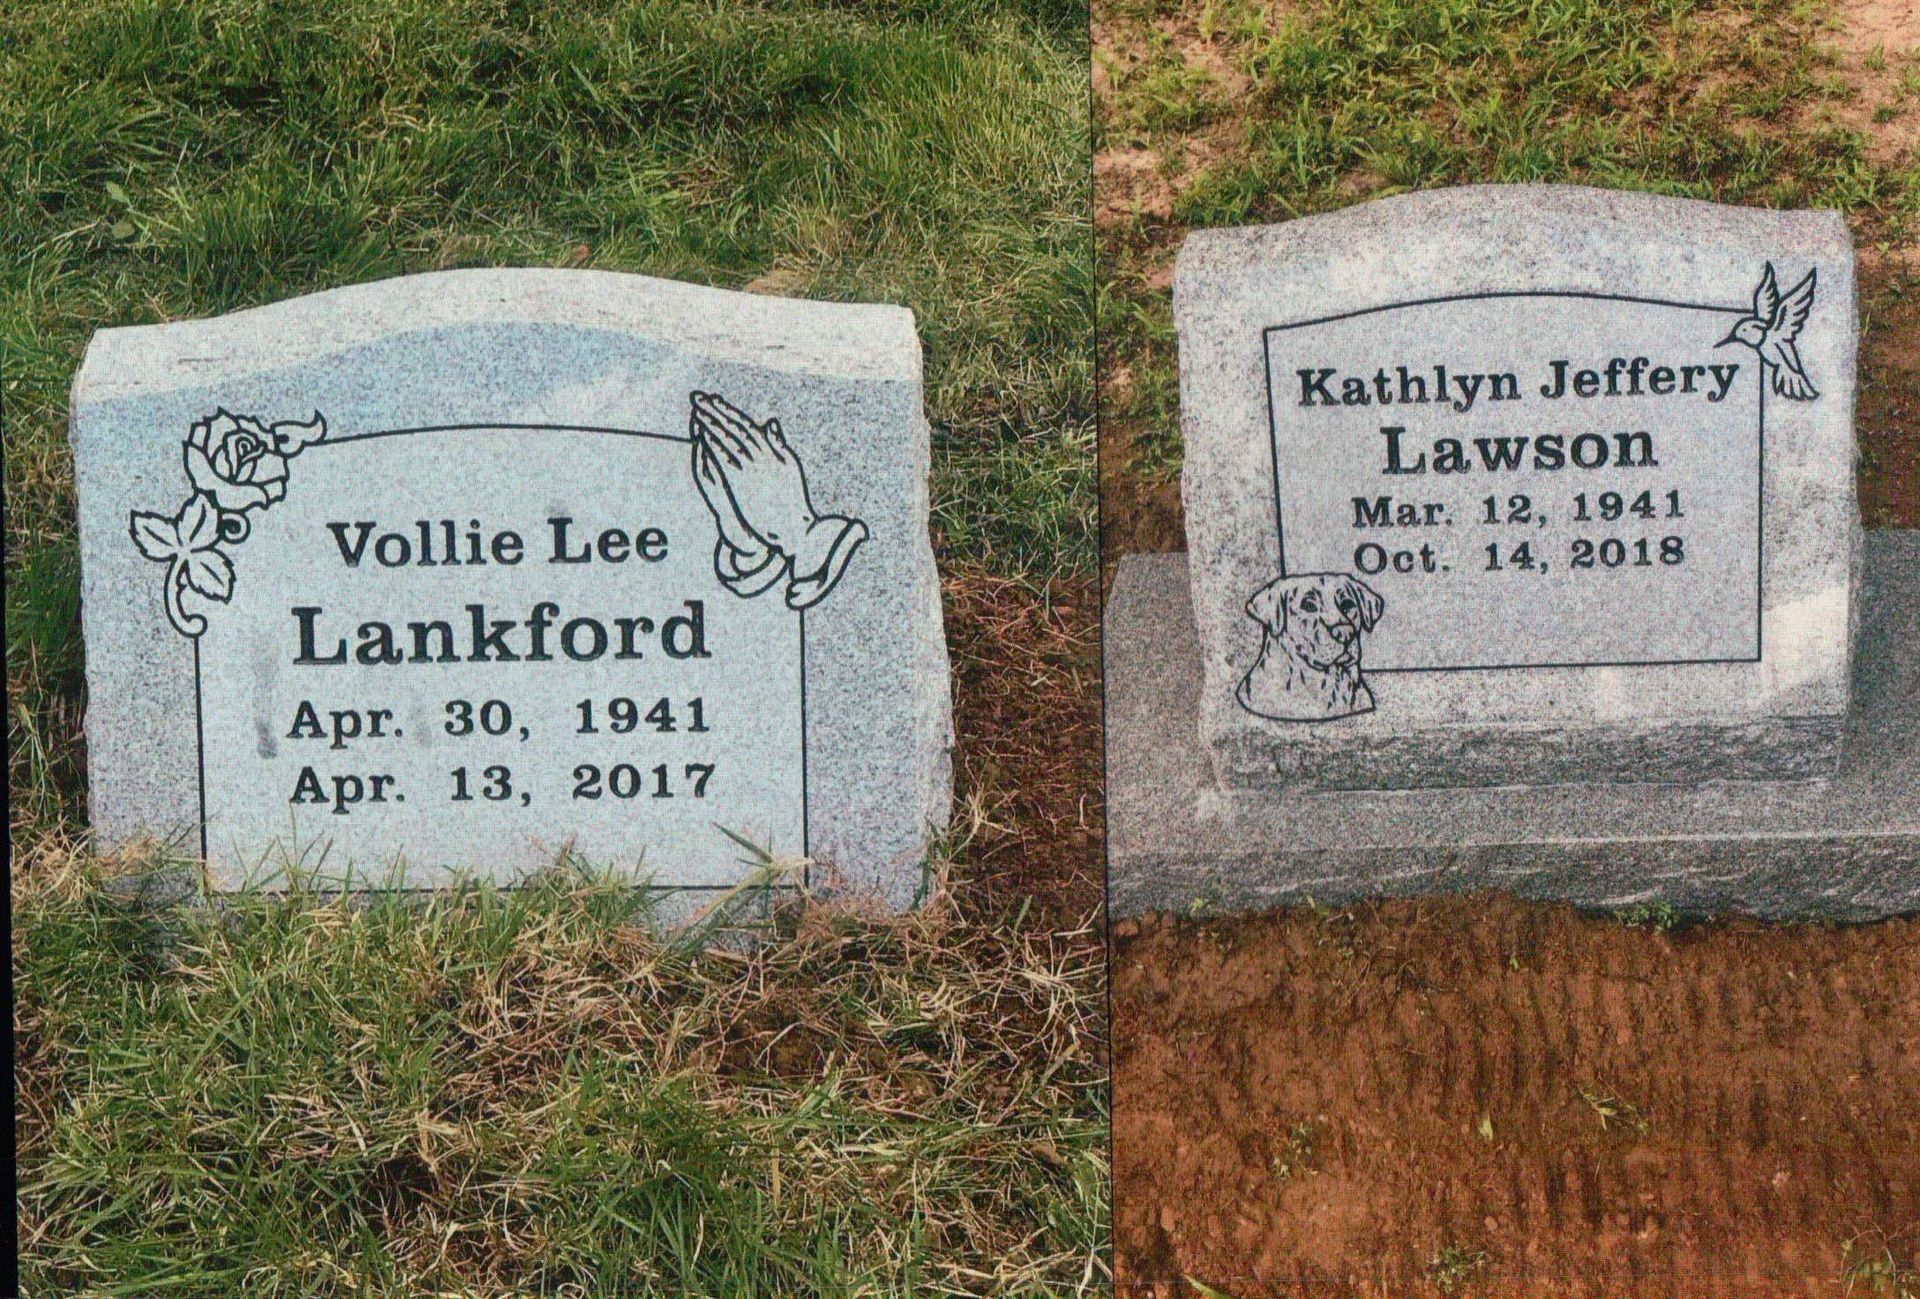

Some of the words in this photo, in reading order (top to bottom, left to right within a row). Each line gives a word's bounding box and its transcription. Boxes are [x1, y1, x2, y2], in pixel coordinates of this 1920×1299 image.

[1296, 364, 1522, 413] Kathlyn
[1540, 357, 1740, 402] Jeffery
[1380, 426, 1659, 475] Lawson
[1351, 495, 1452, 528] Mar.
[1482, 494, 1547, 528] 12,
[1572, 489, 1685, 522] 1941
[326, 519, 524, 567] Vollie
[547, 516, 669, 564] Lee
[1353, 541, 1450, 574] Oct.
[1484, 541, 1549, 574] 14,
[1570, 535, 1685, 569] 2018
[291, 600, 712, 666] Lankford
[286, 700, 404, 750] Apr.
[444, 699, 530, 741] 30,
[576, 696, 710, 734] 1941
[289, 765, 405, 814] Apr.
[450, 764, 531, 807] 13,
[572, 763, 716, 801] 2017
